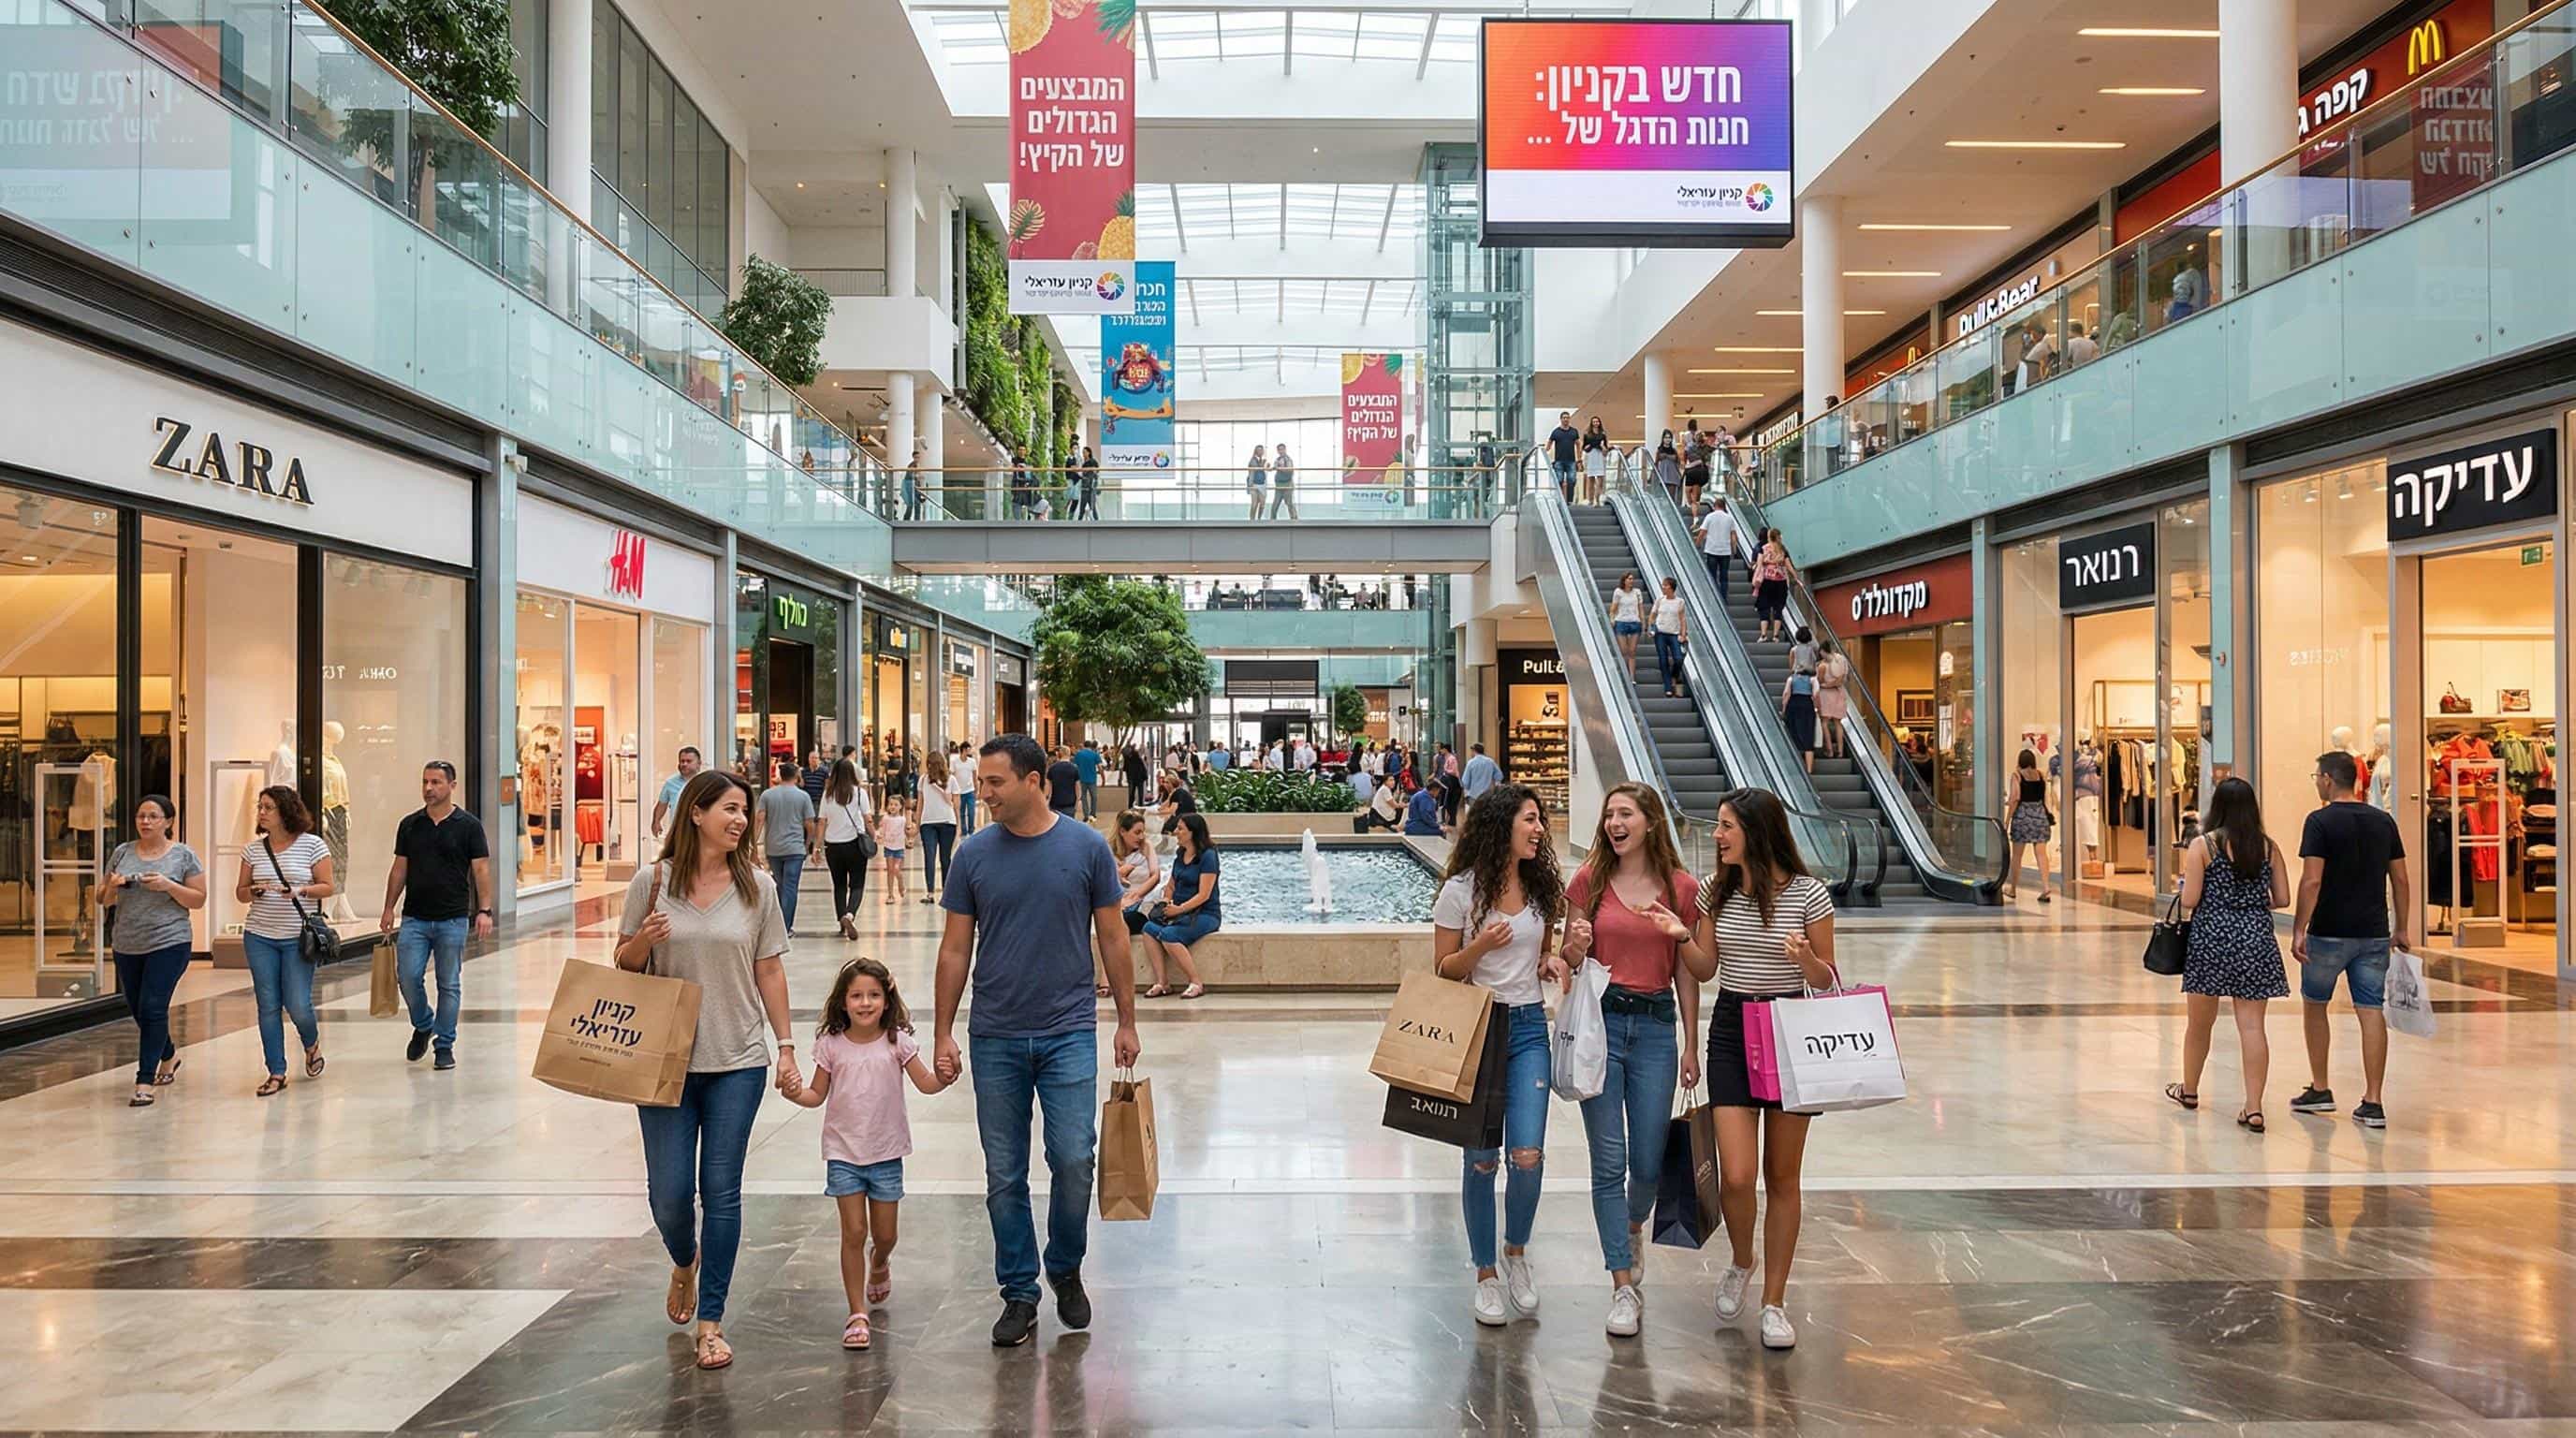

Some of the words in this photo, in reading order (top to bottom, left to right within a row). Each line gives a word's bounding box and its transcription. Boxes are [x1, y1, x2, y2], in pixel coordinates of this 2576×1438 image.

[1020, 77, 1124, 100] המבצעים
[1535, 66, 1650, 111] בקניון:
[1661, 66, 1741, 103] חדש
[2315, 68, 2367, 125] קפה
[1028, 106, 1117, 134] הגדולים
[1561, 110, 1603, 144] של
[1612, 110, 1677, 145] הדגל
[1686, 117, 1749, 145] חנות
[1019, 141, 1083, 172] הקיץ!
[1090, 139, 1124, 167] של
[1677, 184, 1717, 198] עזריאלי
[1720, 187, 1743, 200] קניון
[1025, 275, 1066, 288] עזריאלי
[1069, 277, 1093, 290] קניון
[150, 416, 315, 506] ZARA
[2394, 446, 2533, 527] עדיקה
[2066, 545, 2139, 587] רנואר
[1523, 659, 1565, 674] Pull&
[591, 998, 637, 1025] קניון
[570, 1014, 642, 1047] עזריאלי
[1398, 1020, 1456, 1045] ZARA
[1805, 1032, 1875, 1059] עדיקה
